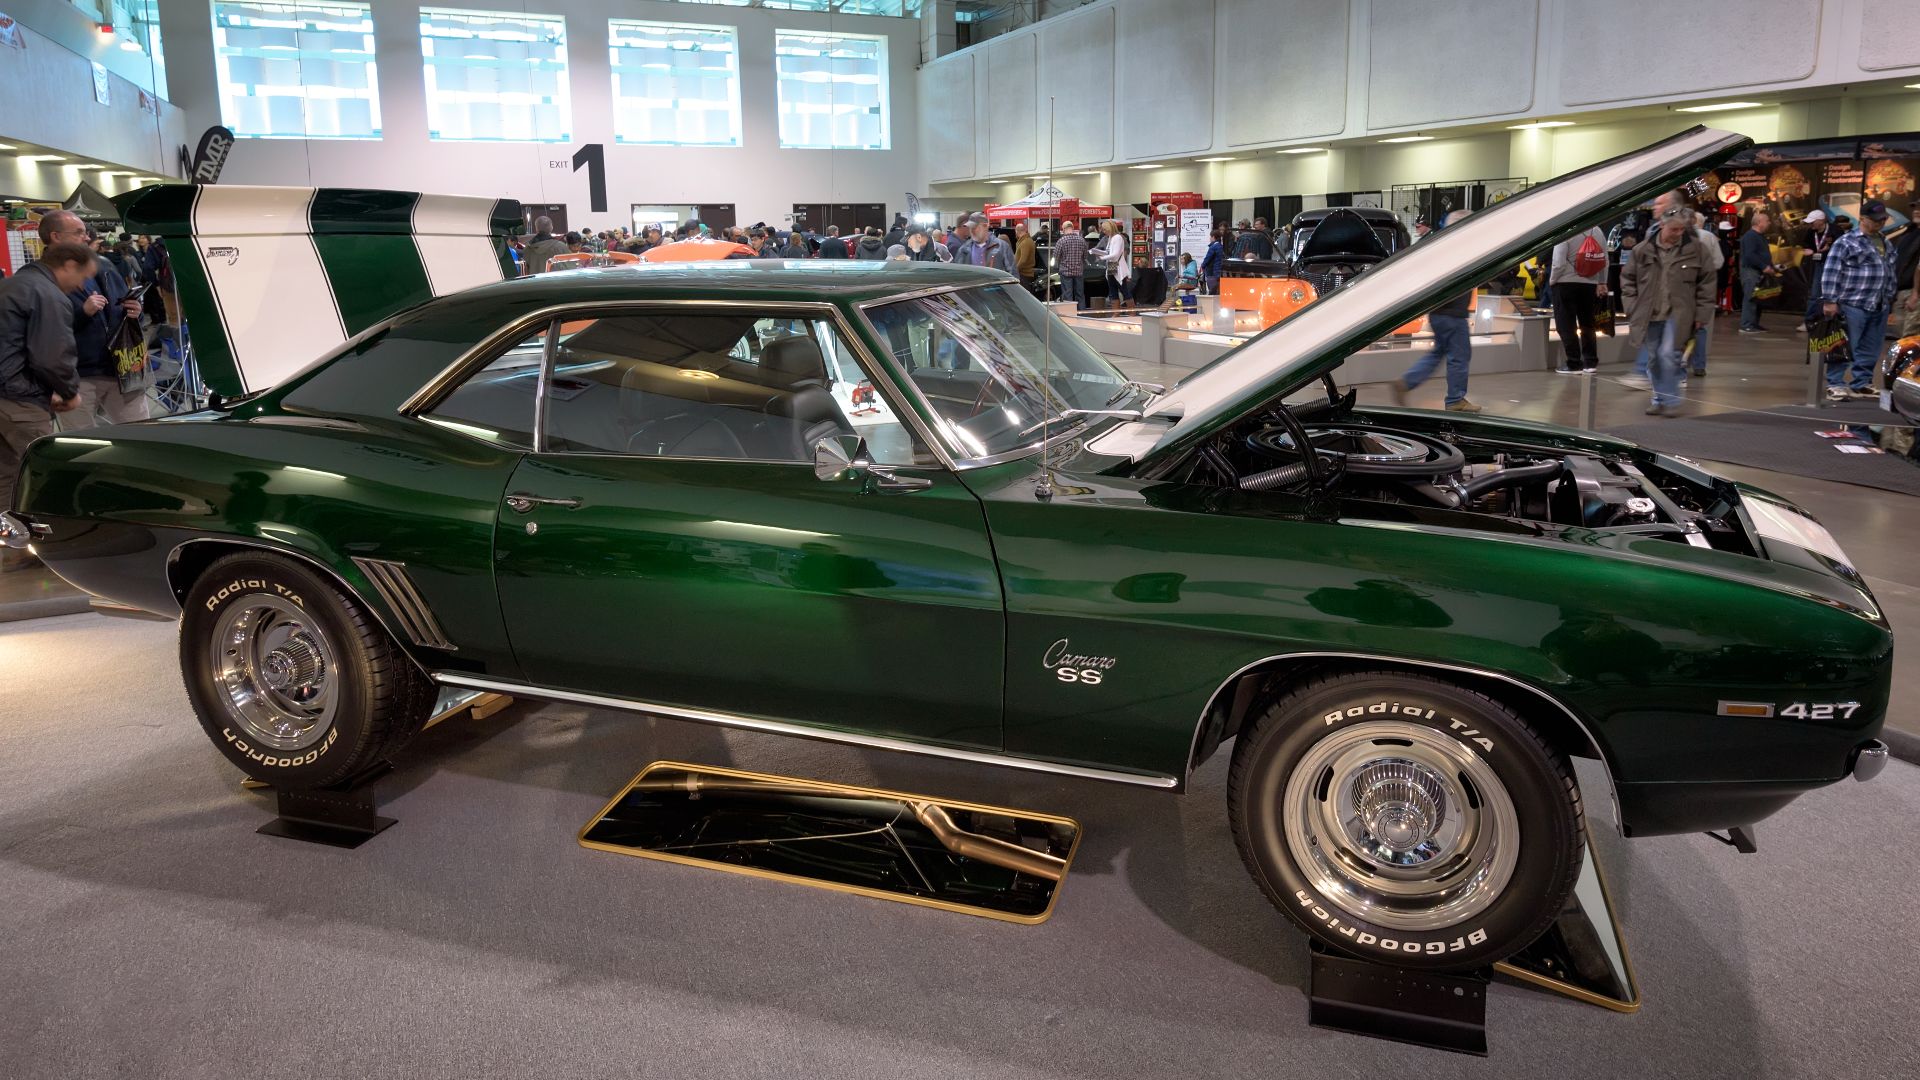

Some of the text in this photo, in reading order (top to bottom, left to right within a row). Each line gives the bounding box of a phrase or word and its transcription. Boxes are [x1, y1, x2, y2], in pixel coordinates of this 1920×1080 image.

[195, 133, 229, 182] TMR
[549, 143, 608, 213] EXIT 1
[205, 578, 305, 612] Radial T/A
[1043, 638, 1116, 669] Camaro
[1057, 667, 1103, 685] SS
[1323, 701, 1495, 753] Radial T/A
[1780, 701, 1861, 720] 427
[222, 726, 339, 768] BFGoodrich
[1294, 888, 1489, 955] BFGoodrich
